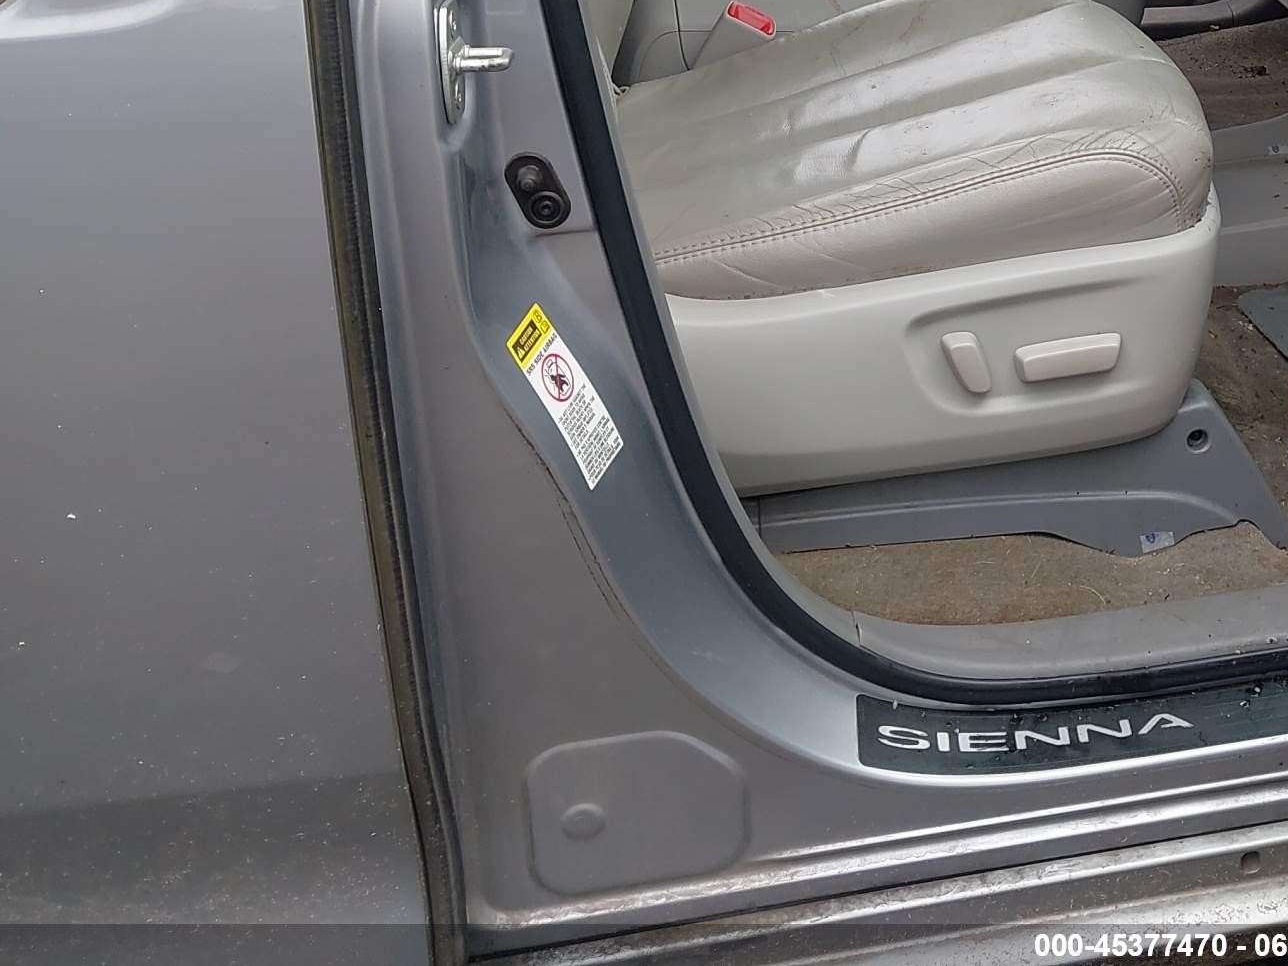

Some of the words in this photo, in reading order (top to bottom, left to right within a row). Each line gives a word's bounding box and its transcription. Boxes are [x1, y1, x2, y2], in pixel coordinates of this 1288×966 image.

[519, 325, 534, 346] CAUTION
[523, 329, 541, 352] ATTENTION
[526, 363, 536, 376] SRS
[534, 351, 545, 366] SIDE
[543, 332, 558, 353] AIRBAG
[877, 713, 1194, 753] SIENNA
